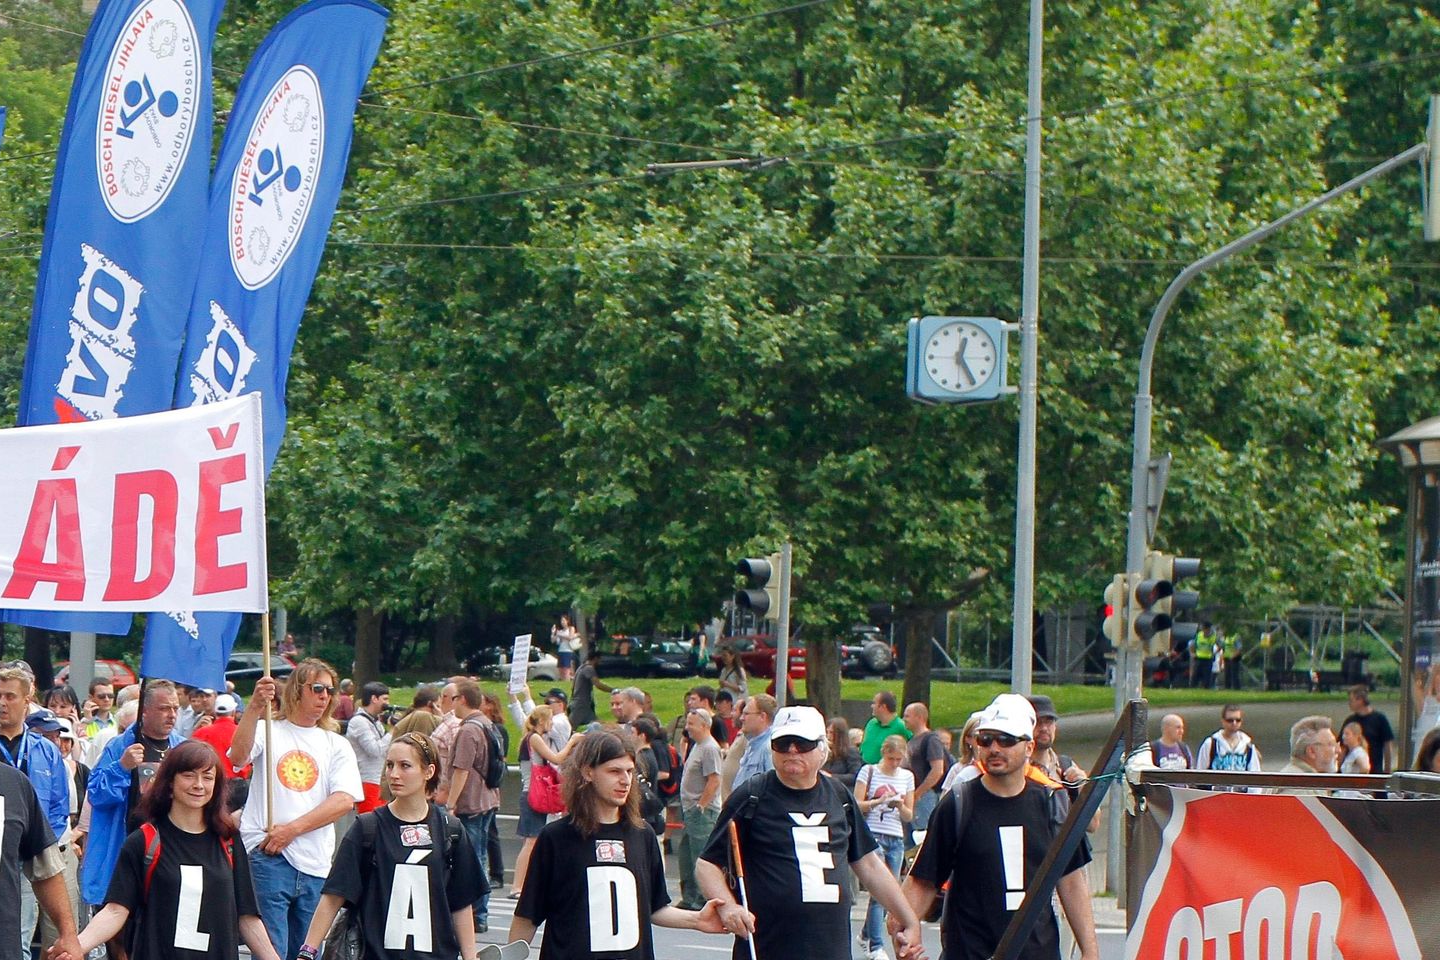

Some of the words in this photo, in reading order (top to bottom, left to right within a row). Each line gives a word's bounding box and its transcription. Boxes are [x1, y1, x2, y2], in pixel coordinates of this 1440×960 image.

[117, 9, 155, 70] JIHLAVA
[103, 74, 123, 132] DIESEL
[154, 36, 193, 194] www.odborybosch.cz
[103, 138, 119, 197] BOSCH
[237, 139, 259, 198] DIESEL
[269, 114, 318, 266] www.odborybosch.cz
[234, 200, 245, 260] BOSCH
[383, 849, 433, 953] Á
[788, 812, 840, 904] Ě
[996, 826, 1026, 911] !
[173, 864, 211, 953] L
[586, 865, 641, 953] D
